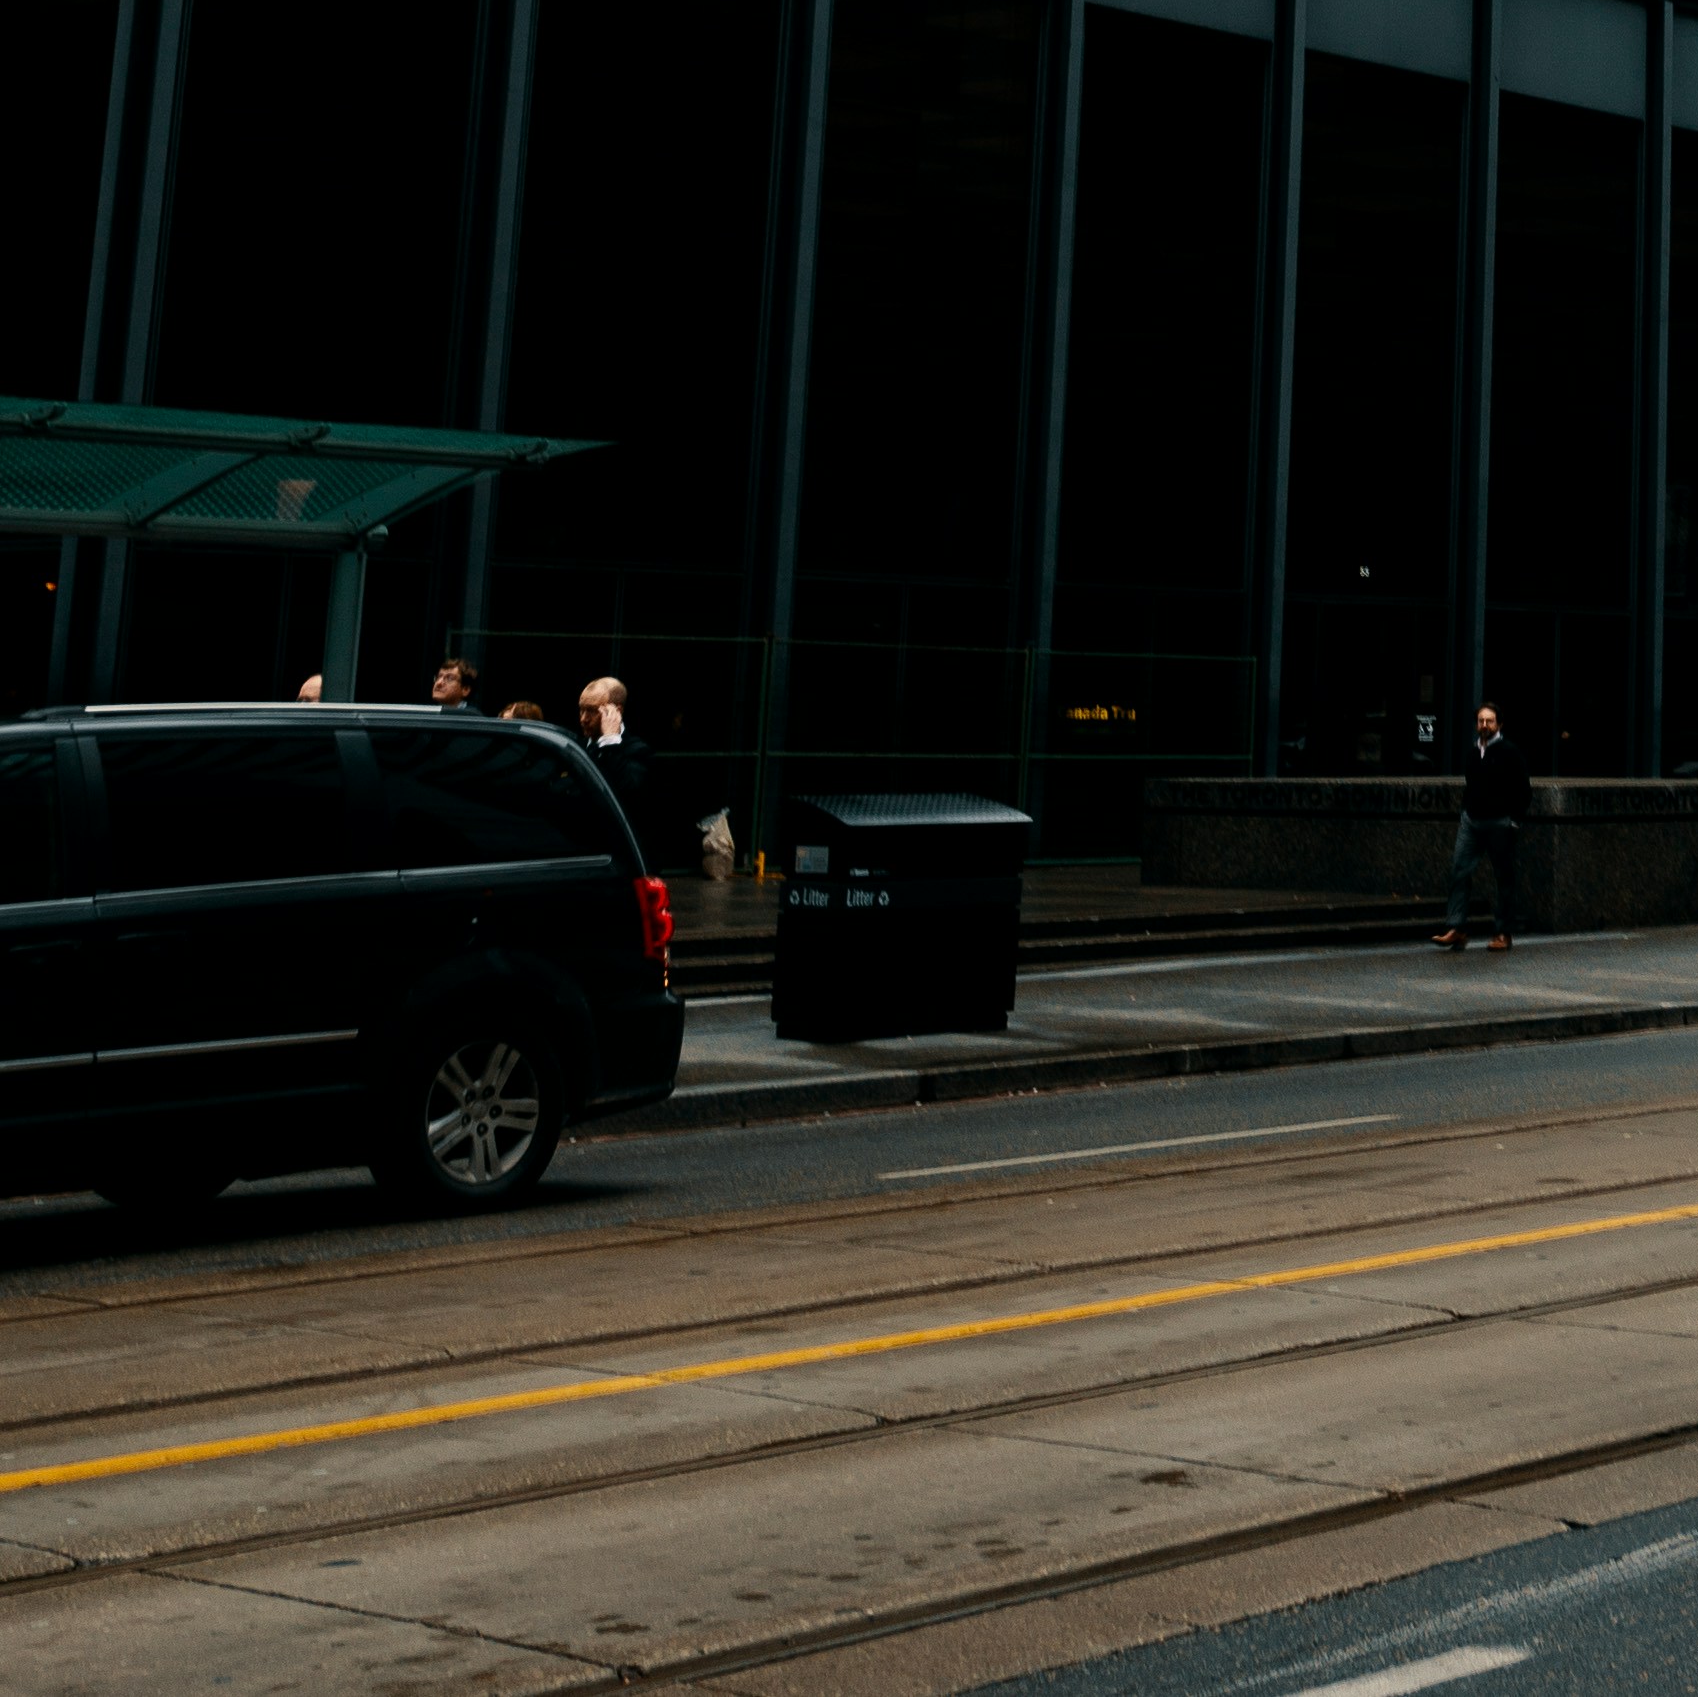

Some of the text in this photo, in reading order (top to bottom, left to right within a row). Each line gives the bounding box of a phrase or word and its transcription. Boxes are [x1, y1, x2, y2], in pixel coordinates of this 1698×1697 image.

[1057, 704, 1109, 721] anada
[803, 887, 874, 907] Litter Litter
